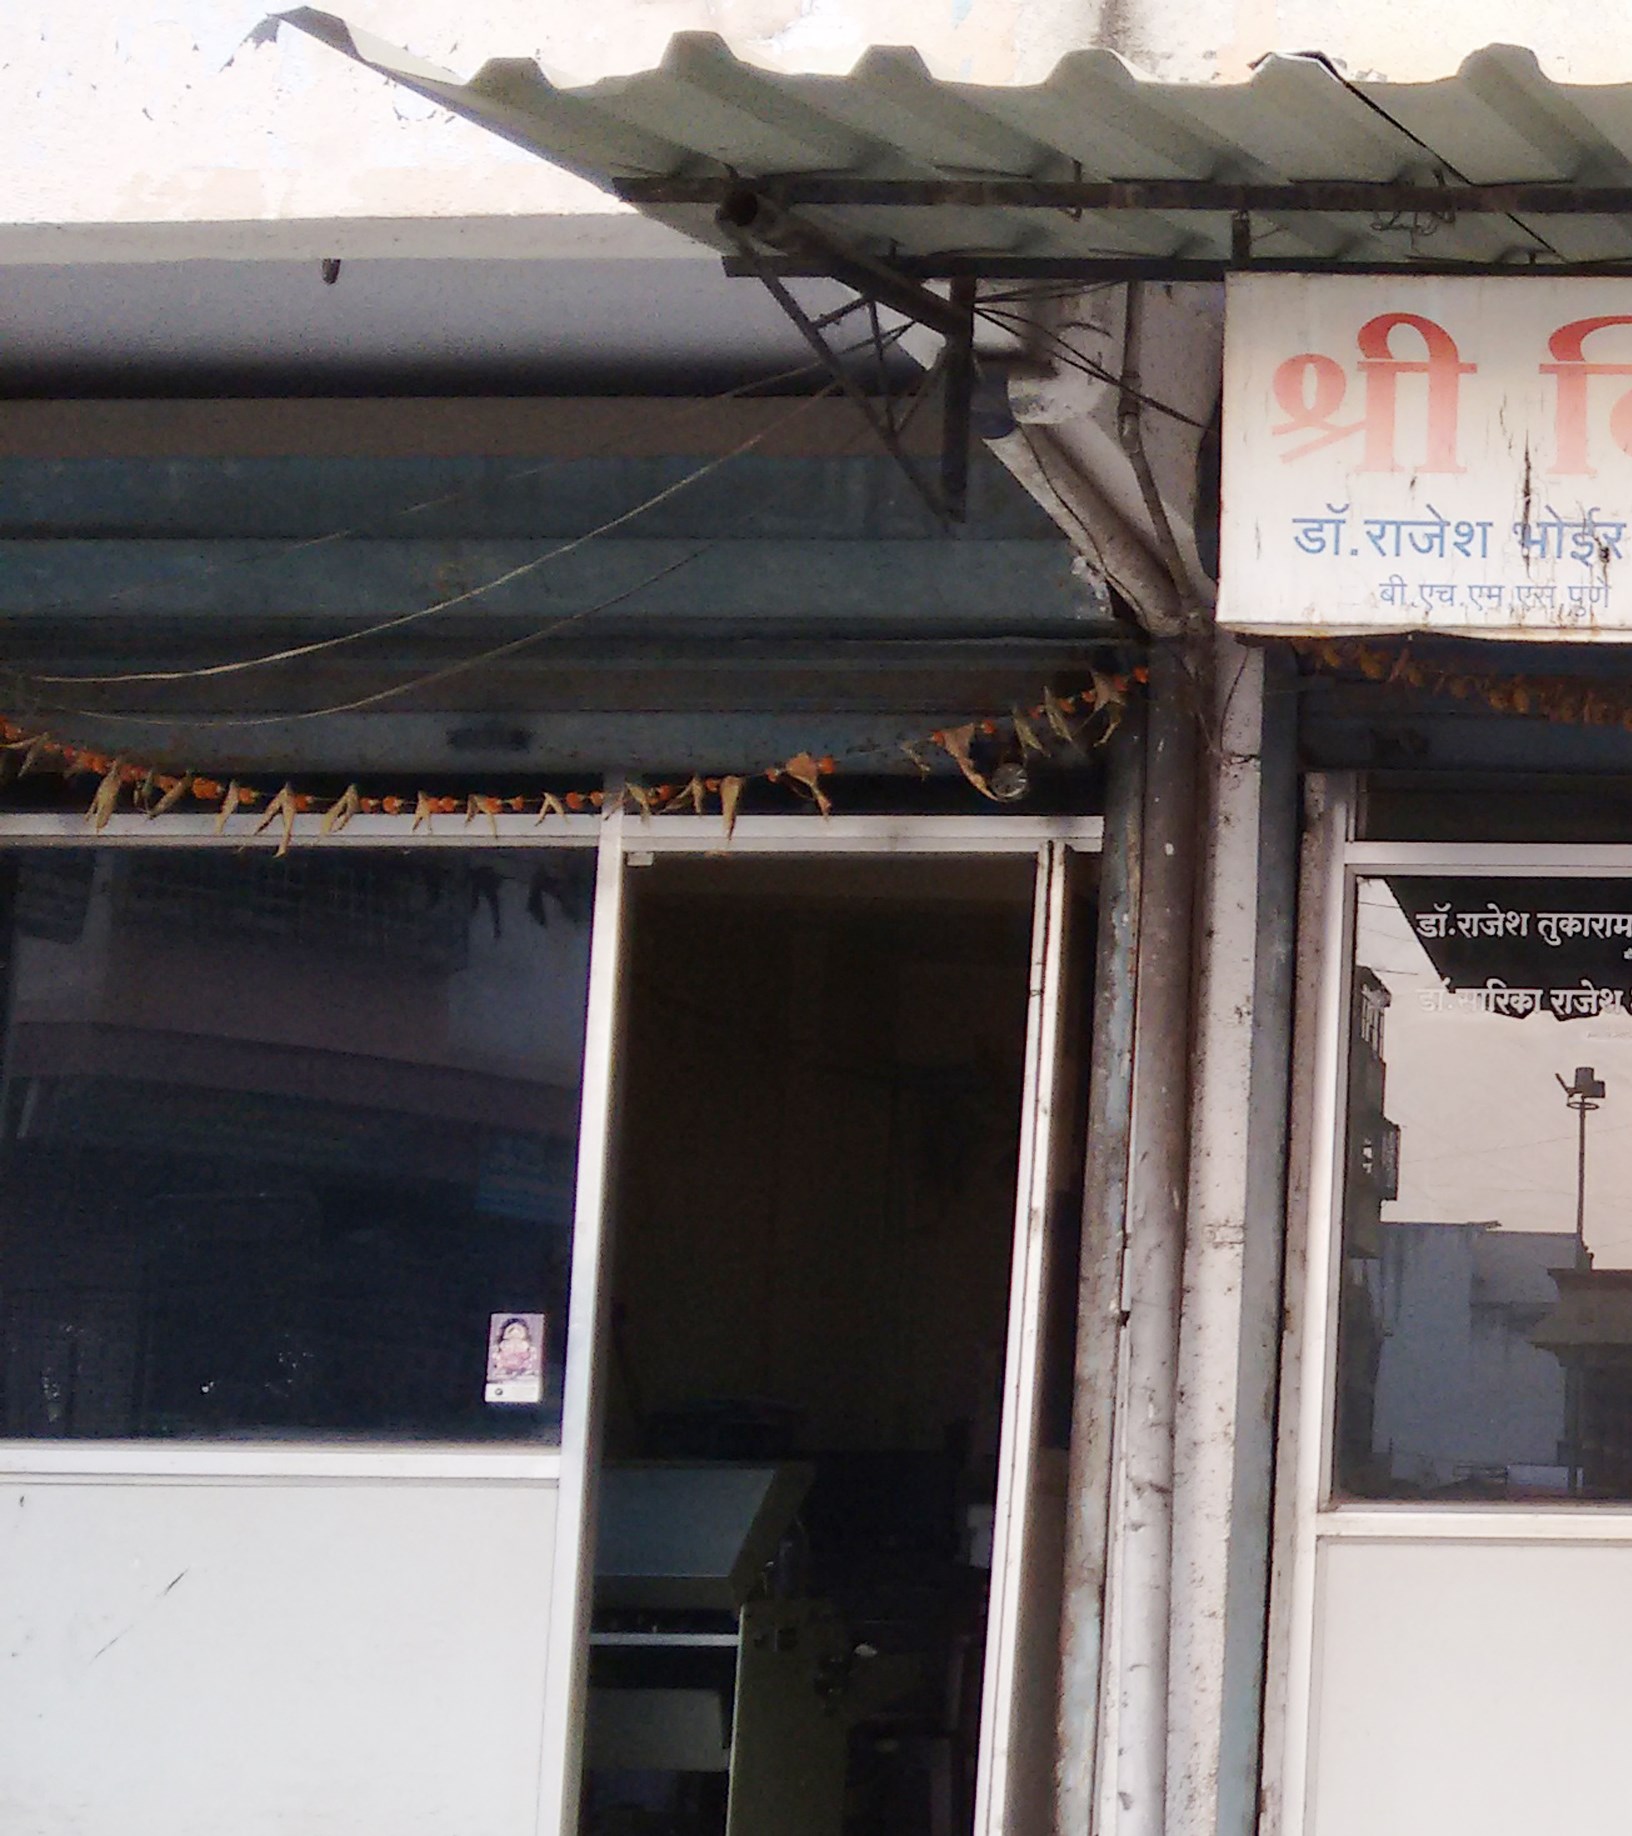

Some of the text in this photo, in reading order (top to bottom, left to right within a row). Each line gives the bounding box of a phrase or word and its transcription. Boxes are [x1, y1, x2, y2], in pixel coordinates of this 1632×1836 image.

[1271, 312, 1478, 477] श्री
[1292, 504, 1627, 567] डॉ.राजेश भोईर
[1415, 903, 1530, 940] डॉ.राजेश
[1549, 979, 1624, 1016] राजेश
